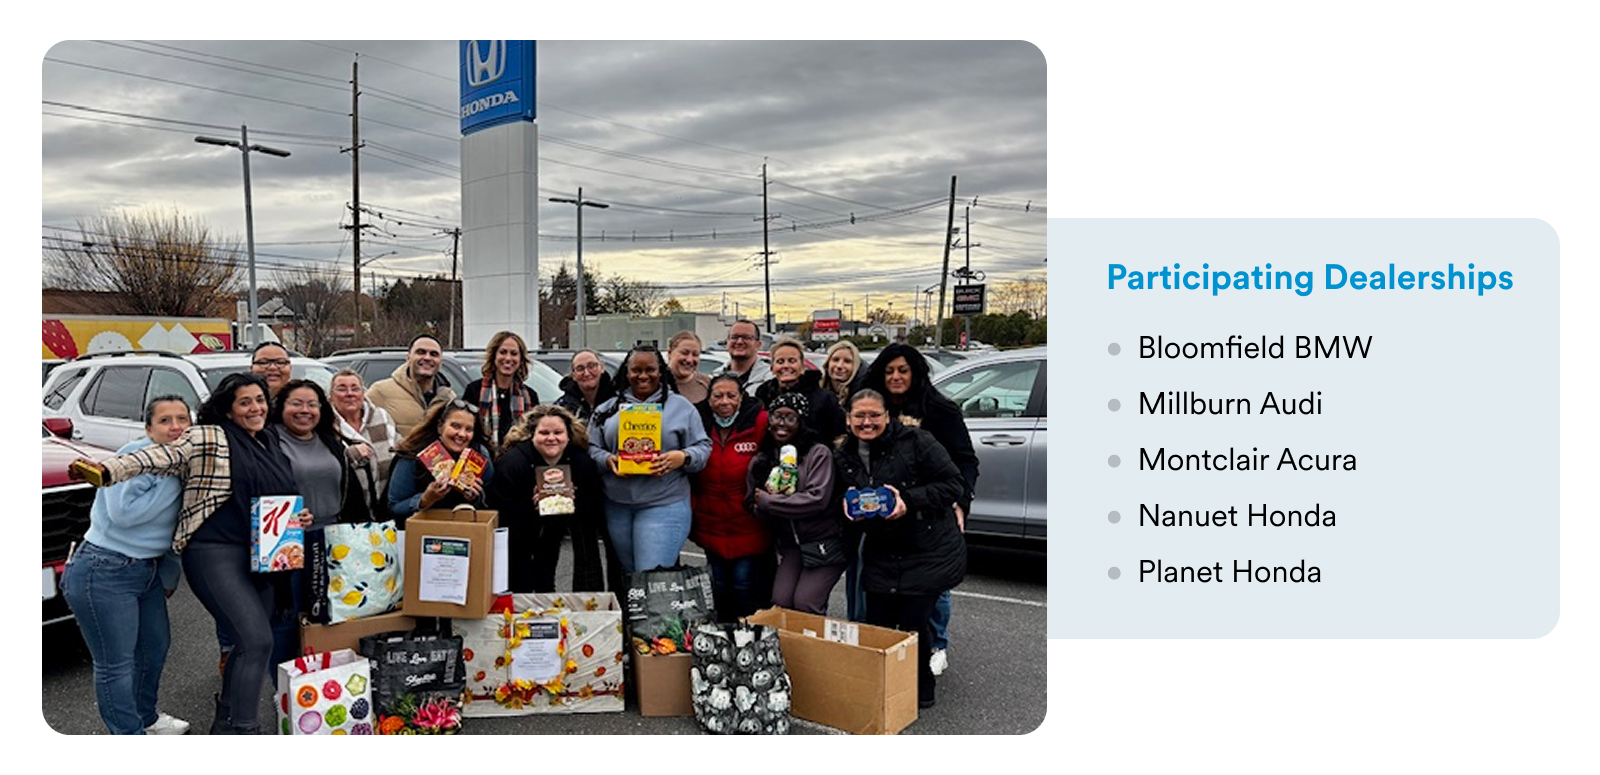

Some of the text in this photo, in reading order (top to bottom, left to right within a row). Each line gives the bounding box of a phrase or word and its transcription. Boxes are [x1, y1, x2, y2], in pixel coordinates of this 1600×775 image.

[461, 90, 519, 118] HONDA
[623, 420, 657, 432] Cheerios
[262, 500, 291, 537] K
[647, 582, 667, 593] LIVE
[386, 651, 407, 664] LIVE
[430, 650, 447, 661] EAT
